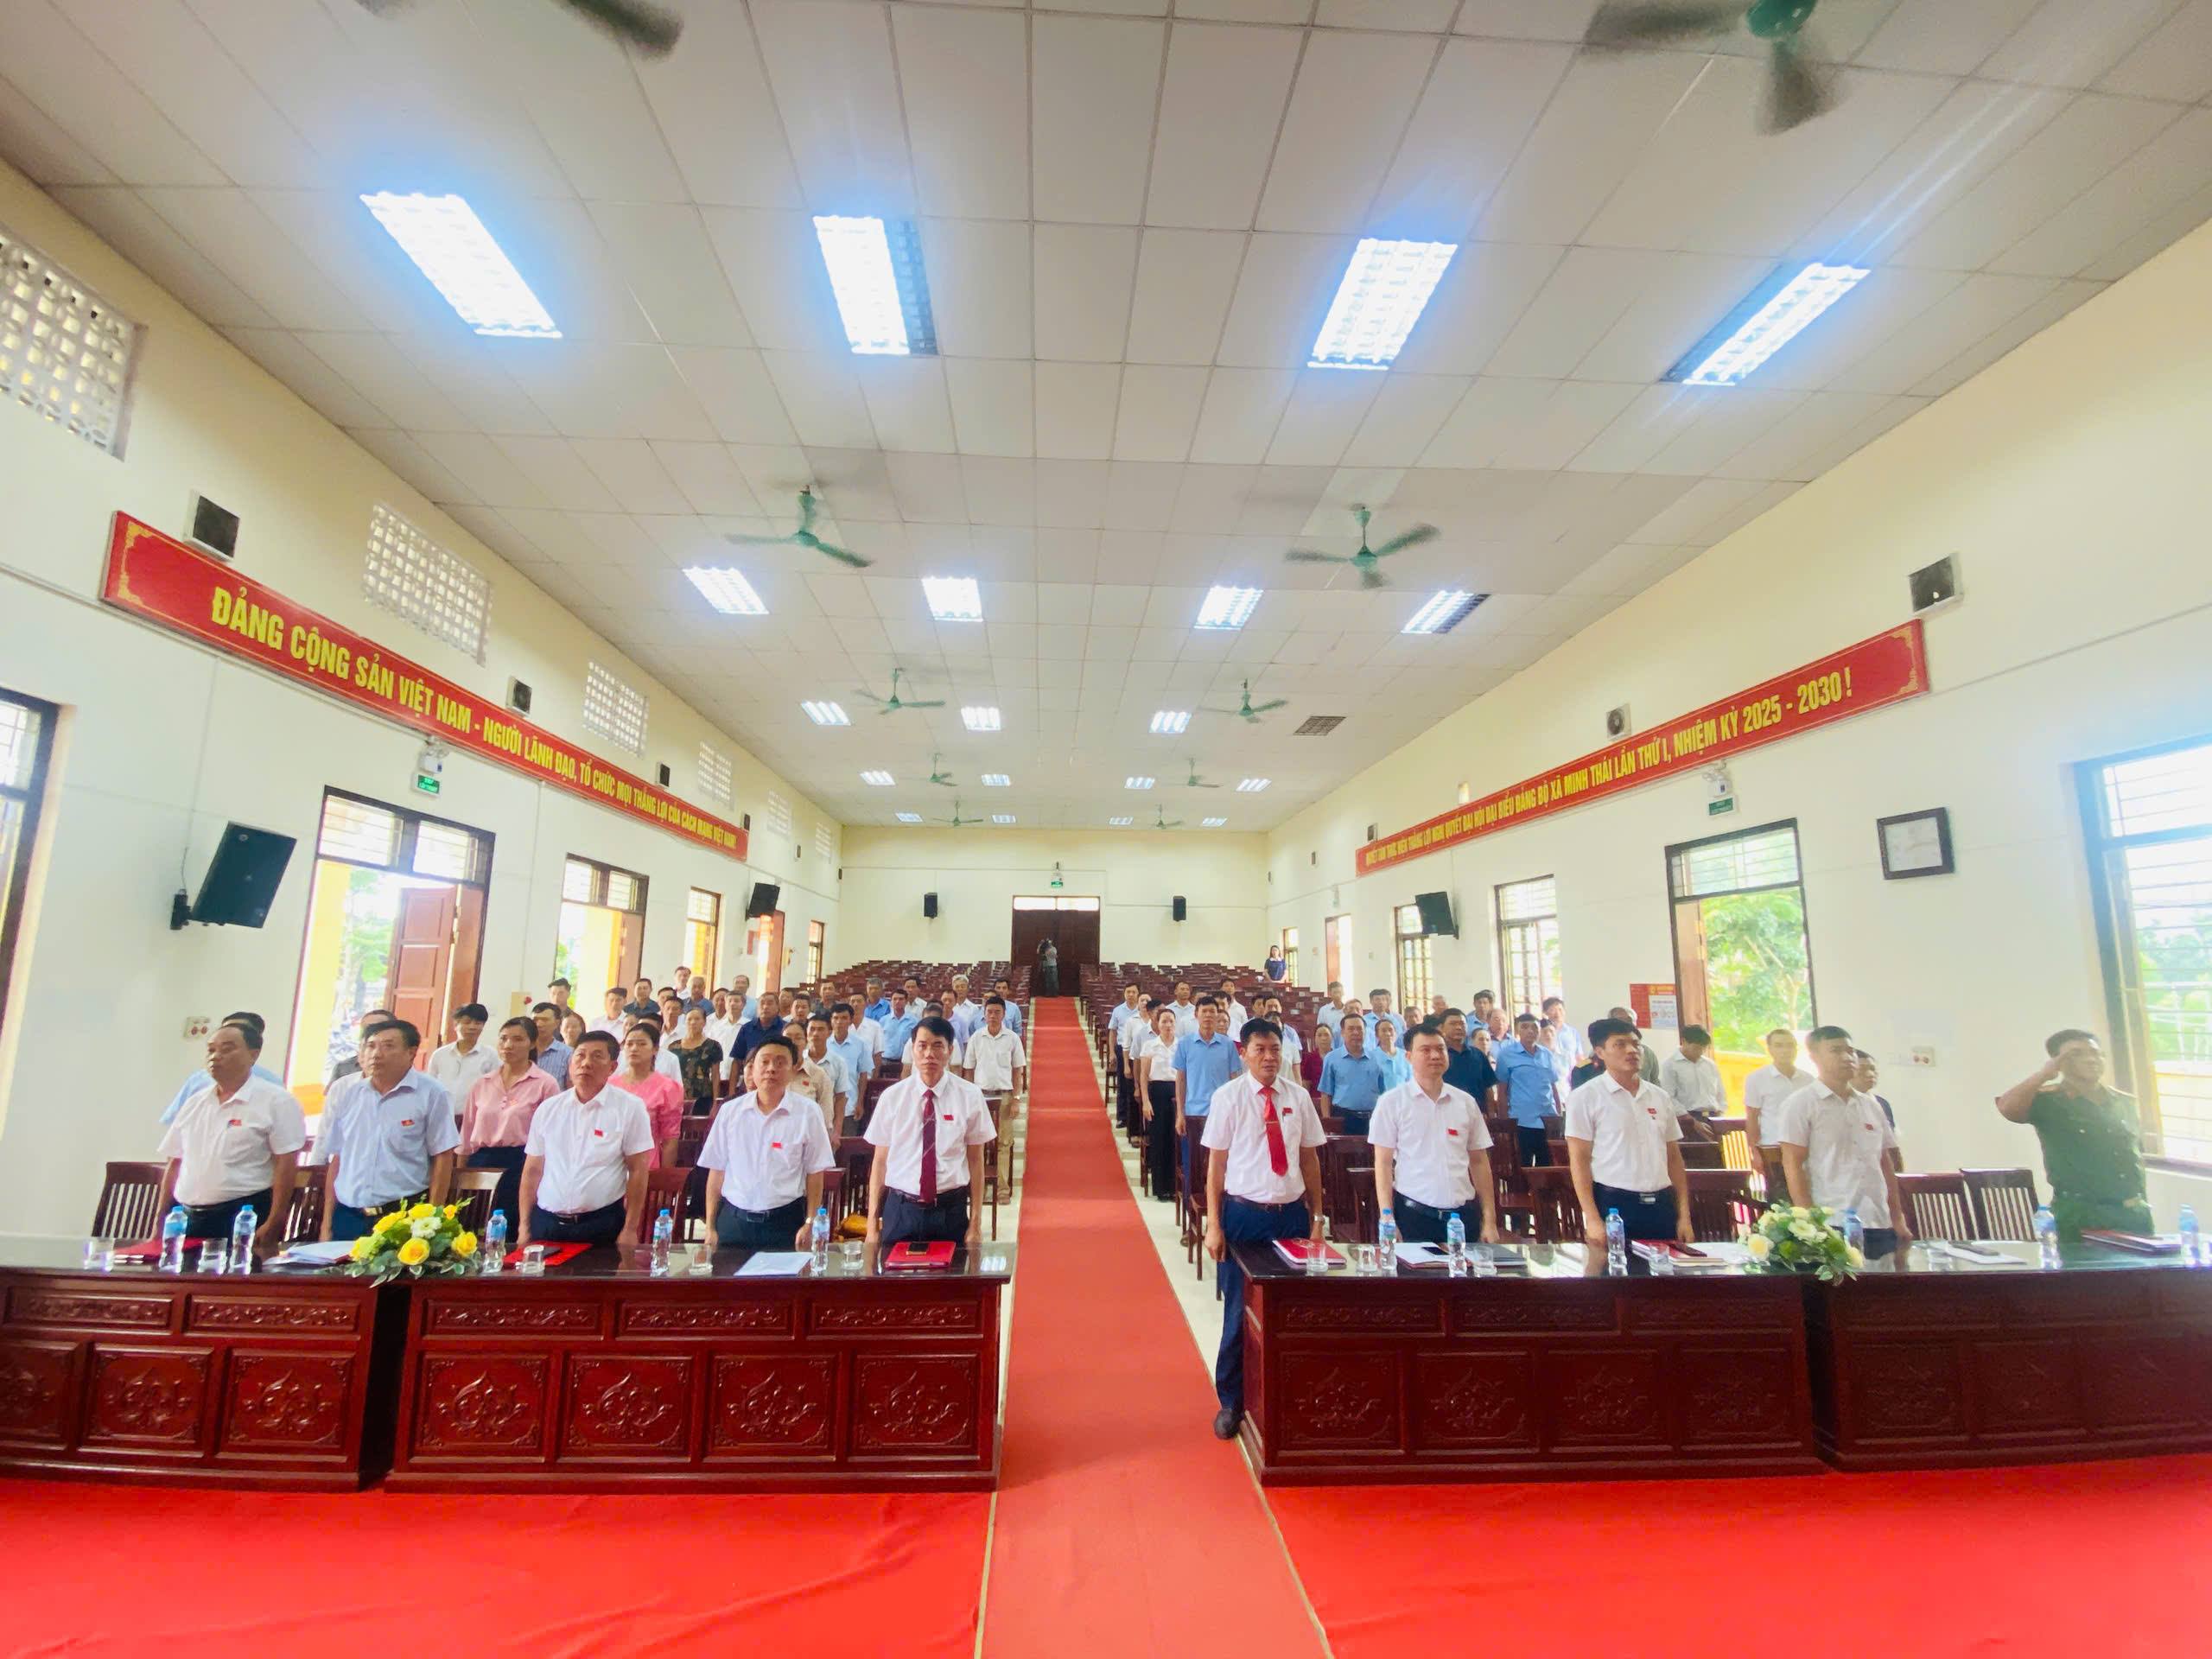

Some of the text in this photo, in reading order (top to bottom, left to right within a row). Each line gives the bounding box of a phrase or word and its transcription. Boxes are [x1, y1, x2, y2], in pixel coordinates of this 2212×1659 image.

[212, 586, 284, 650] ĐẢNG
[290, 625, 351, 680] CỘNG
[355, 652, 395, 699] SẢN
[398, 675, 434, 718] VIỆT
[436, 694, 472, 734] NAM
[483, 716, 521, 757] NGƯỜI
[524, 735, 553, 770] LÃNH
[1550, 774, 1563, 801] XÃ
[1564, 768, 1588, 796] MINH
[1590, 756, 1612, 787] THÁI
[1637, 736, 1660, 770] THỨ
[1674, 719, 1717, 754] NHIỆM
[1719, 706, 1738, 741] KỲ
[1742, 695, 1782, 734] 2025
[1797, 671, 1842, 714] 2030
